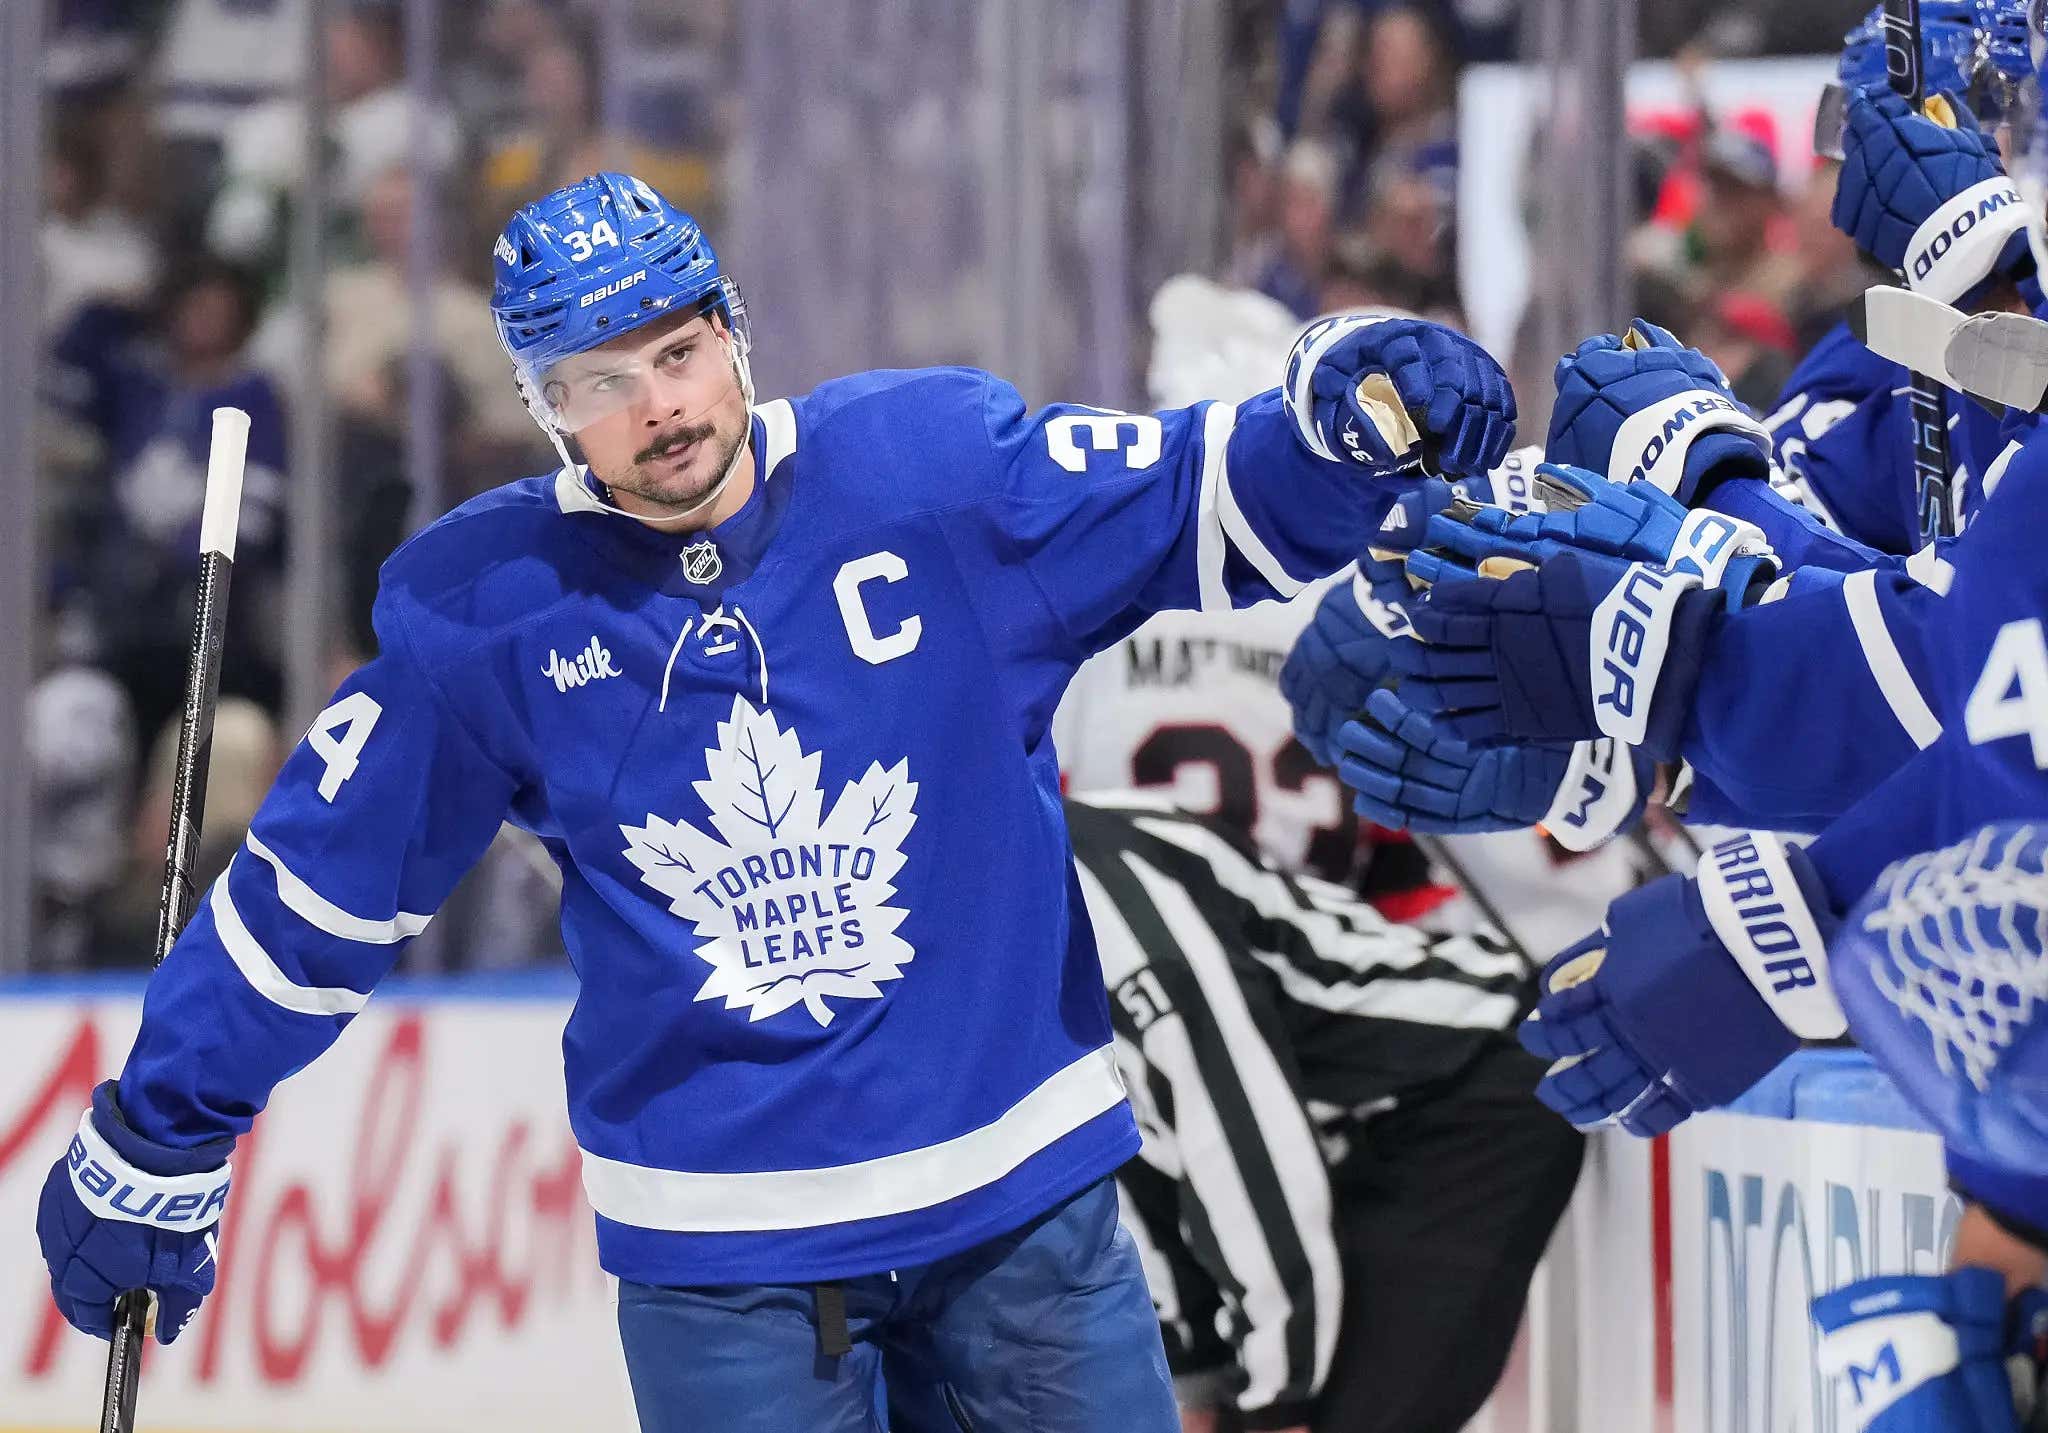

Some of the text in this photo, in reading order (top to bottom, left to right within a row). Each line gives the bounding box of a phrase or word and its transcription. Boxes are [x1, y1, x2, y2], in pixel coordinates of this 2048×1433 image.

[492, 233, 518, 267] OREO
[562, 218, 620, 263] 34
[580, 269, 647, 308] BAUER
[1044, 403, 1163, 473] 3
[1343, 430, 1376, 463] 34
[692, 551, 713, 577] NHL
[832, 550, 922, 665] C
[541, 636, 623, 693] Milk
[1598, 557, 1672, 719] UER
[1964, 617, 2048, 771] 4
[298, 691, 383, 804] 4
[692, 843, 876, 909] TORONTO
[732, 882, 857, 932] MAPLE
[741, 918, 864, 969] LEAFS
[67, 1131, 231, 1212] BAUER
